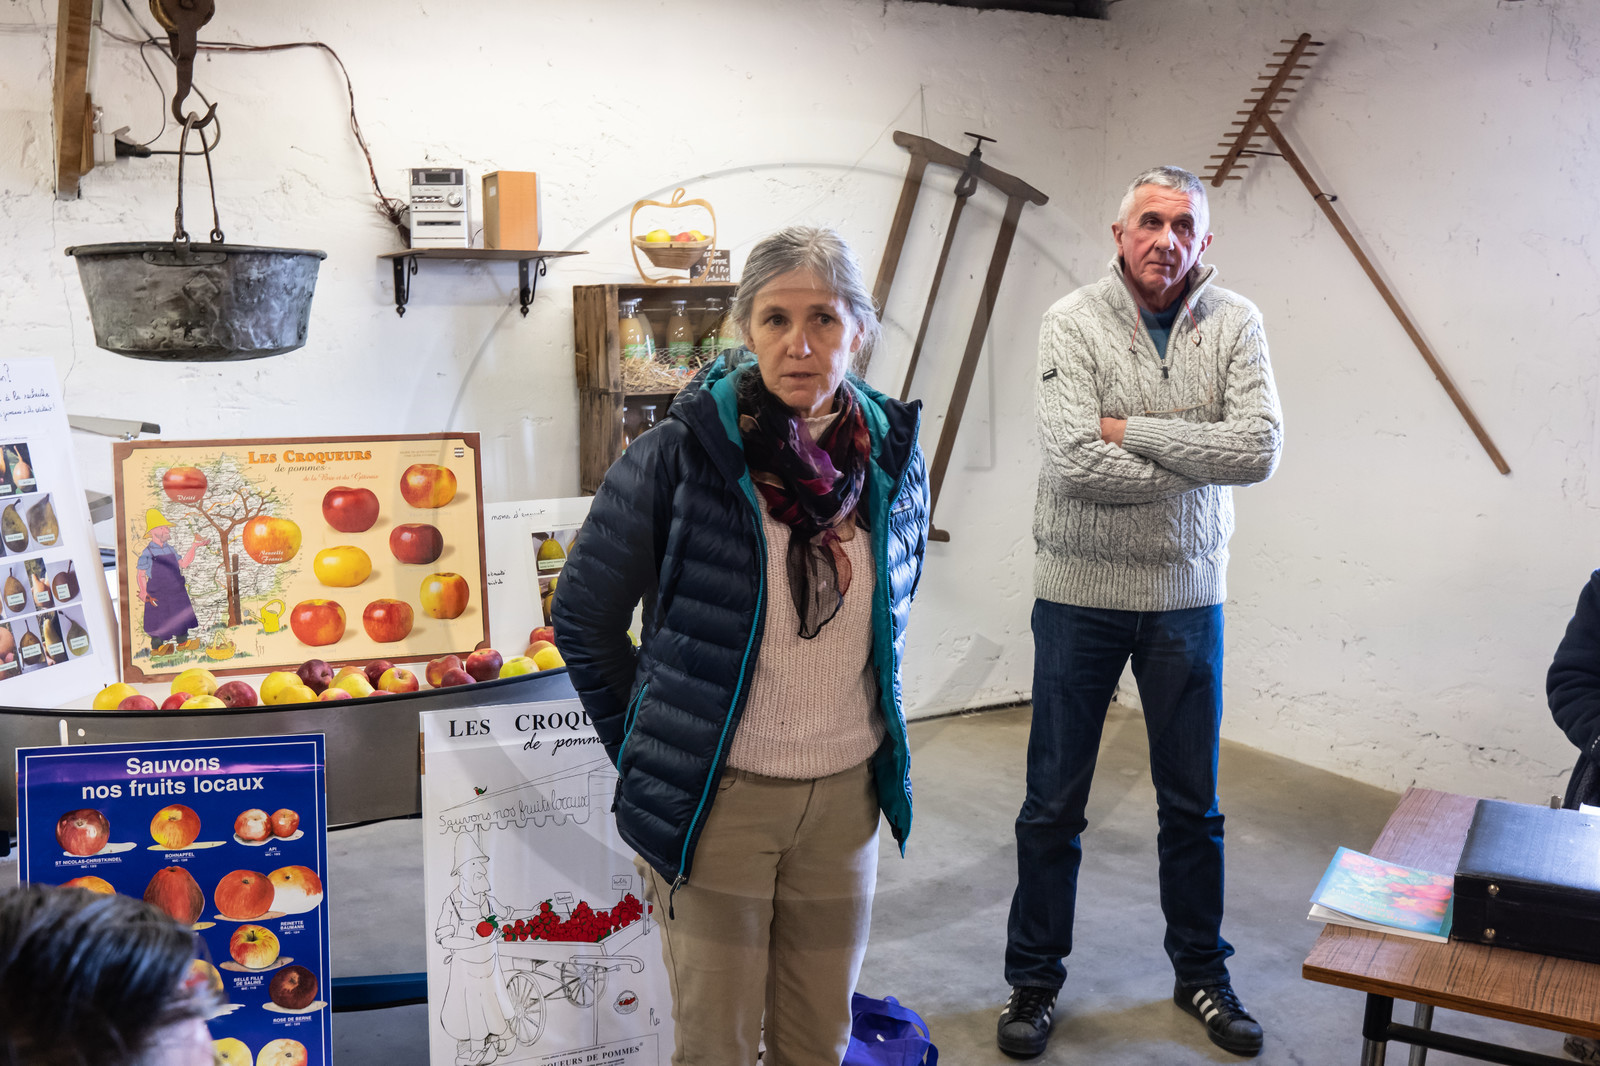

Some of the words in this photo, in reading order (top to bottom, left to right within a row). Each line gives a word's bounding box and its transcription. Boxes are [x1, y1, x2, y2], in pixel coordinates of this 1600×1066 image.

[283, 450, 372, 465] CROQUEURS
[274, 464, 285, 473] de
[287, 465, 326, 475] pommes
[449, 719, 491, 738] LES
[515, 711, 593, 731] CROQU
[523, 732, 542, 751] de
[552, 736, 601, 756] pomm
[126, 757, 221, 775] Sauvons
[82, 784, 122, 800] nos
[129, 778, 186, 797] fruits
[193, 776, 264, 794] locaux
[439, 814, 492, 827] Sauvons
[493, 807, 516, 819] nos
[518, 796, 551, 821] fruits
[551, 789, 590, 811] locaux
[63, 857, 122, 865] NICOLAS-CHRISTKINDEL
[587, 1054, 598, 1062] DE
[602, 1046, 640, 1059] POMMES
